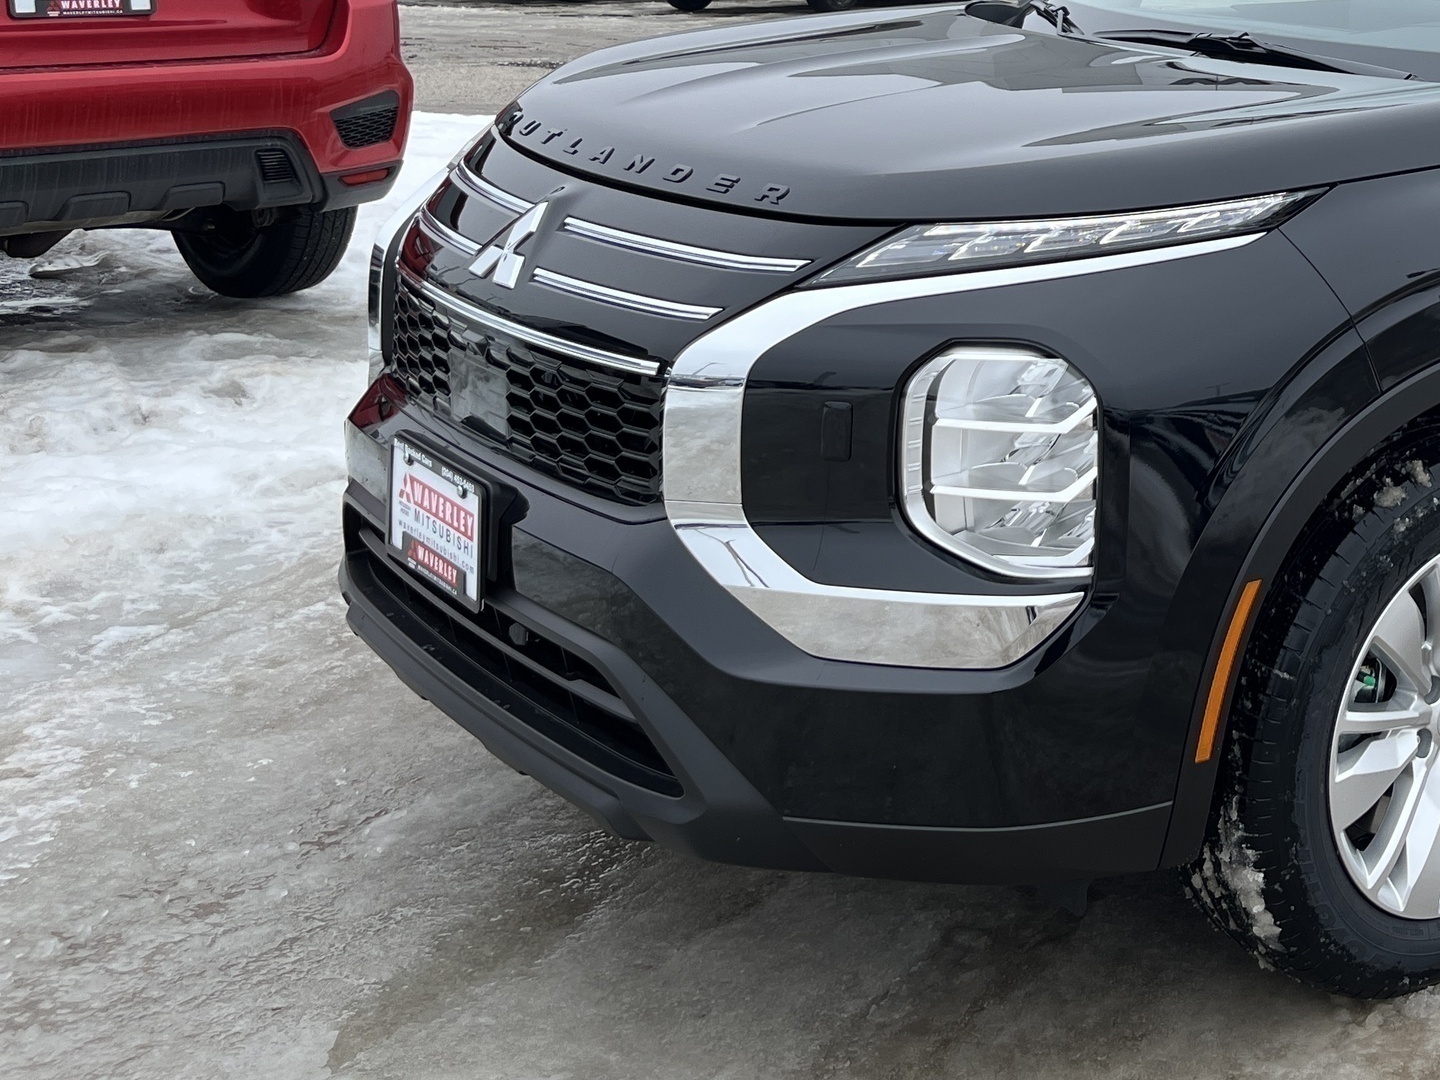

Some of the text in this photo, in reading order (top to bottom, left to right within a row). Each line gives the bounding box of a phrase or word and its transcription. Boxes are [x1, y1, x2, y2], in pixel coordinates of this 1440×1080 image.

[60, 0, 122, 9] WAVERLEY
[507, 111, 791, 205] OUTLANDER
[413, 479, 474, 538] WAVERLEY
[413, 507, 474, 559] MITSUBISHI
[417, 545, 458, 584] WAVERLEY
